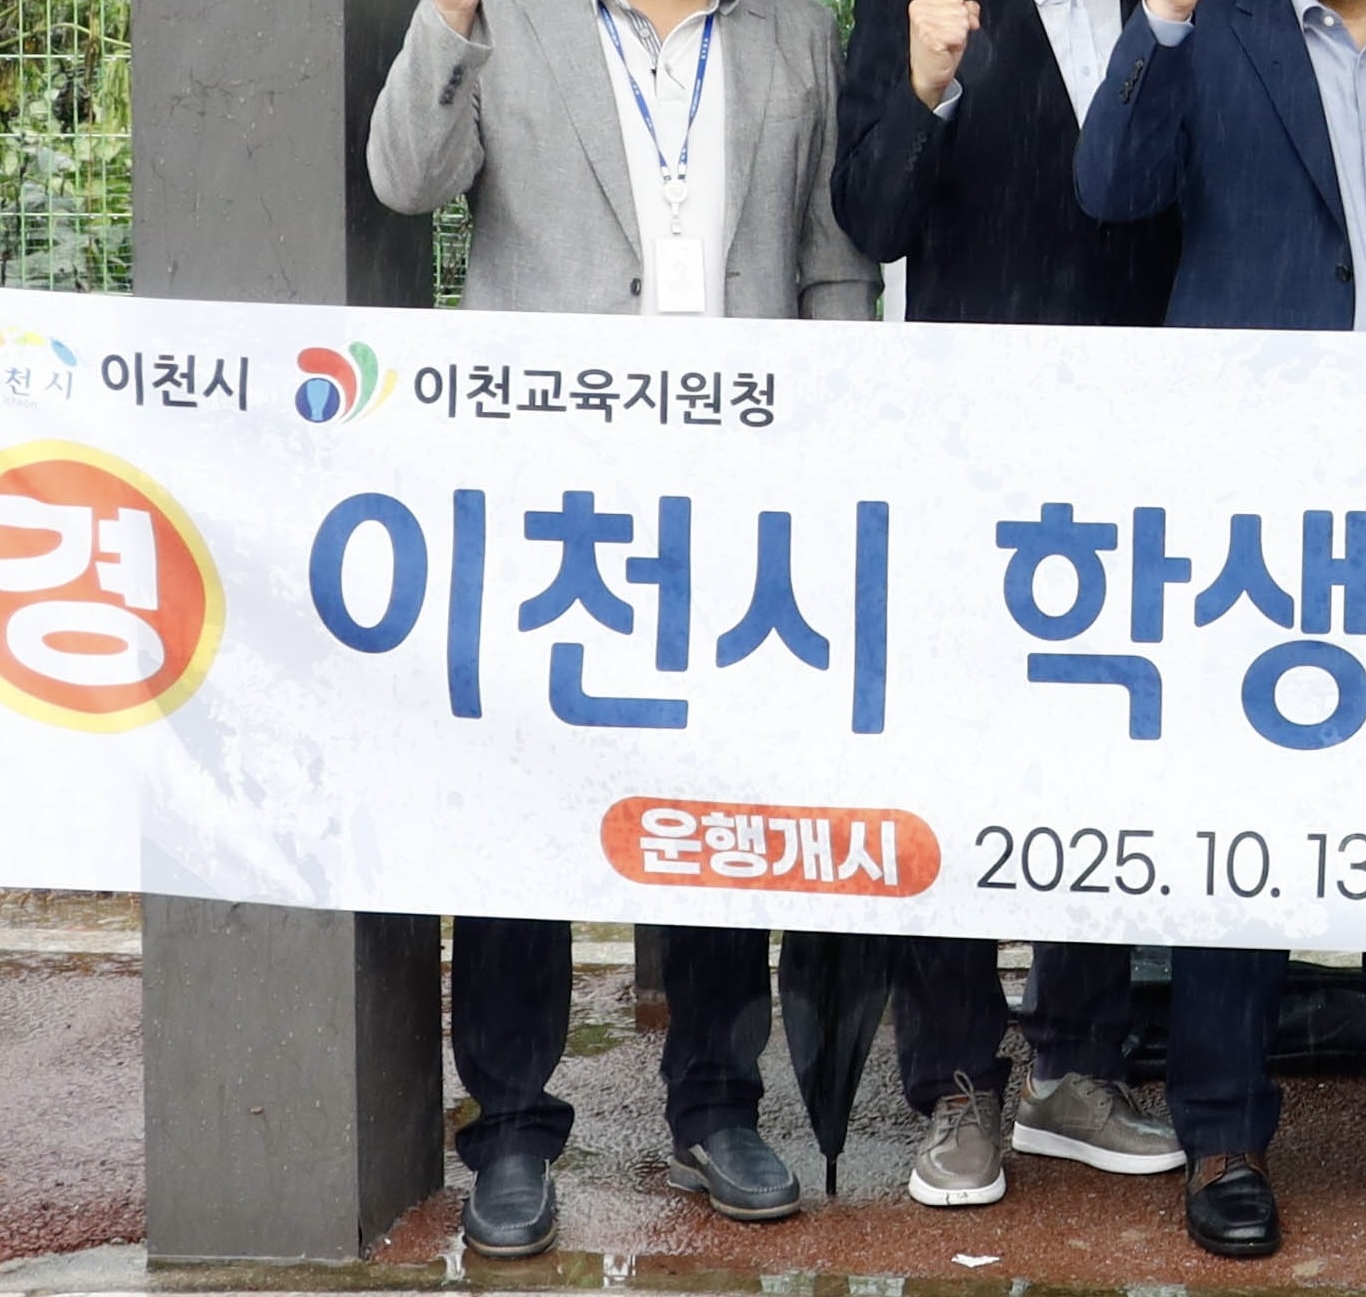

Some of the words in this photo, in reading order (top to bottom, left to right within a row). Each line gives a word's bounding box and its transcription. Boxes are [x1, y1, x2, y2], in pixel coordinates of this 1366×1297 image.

[101, 352, 249, 411] 이천시
[414, 363, 775, 428] 이천교육지원청
[0, 495, 165, 686] 경
[308, 488, 889, 737] 이천시
[638, 807, 901, 886] 운행개시
[974, 825, 1170, 896] 2025.
[1196, 830, 1280, 899] 10.
